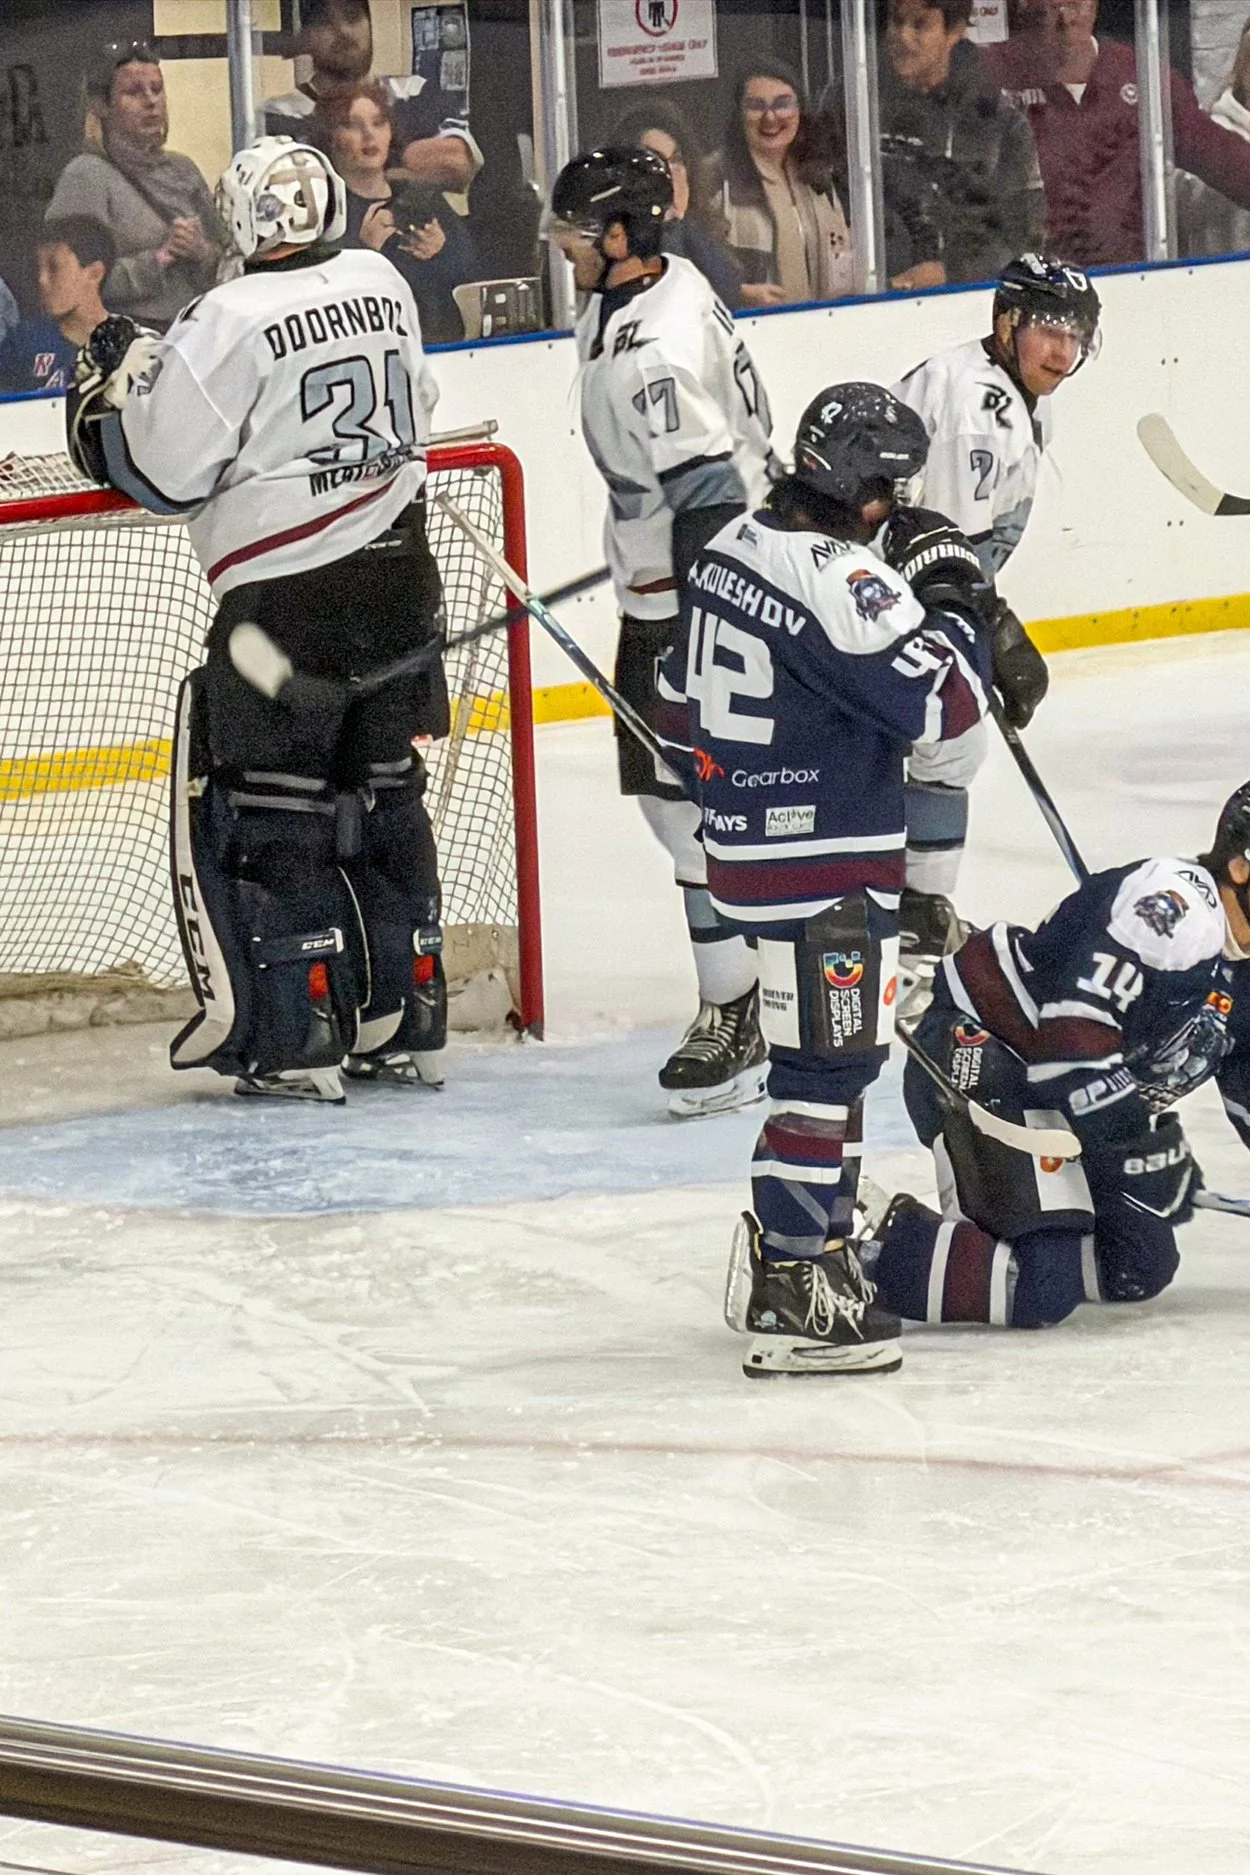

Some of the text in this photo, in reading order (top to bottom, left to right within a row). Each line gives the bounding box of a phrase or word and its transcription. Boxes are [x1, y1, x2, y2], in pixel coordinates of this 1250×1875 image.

[685, 605, 775, 746] 42
[731, 768, 821, 788] Gearbox
[301, 938, 335, 951] CCM
[1076, 952, 1145, 1014] 14
[829, 990, 844, 1048] DISPLAYS
[840, 989, 853, 1037] SCREEN
[850, 988, 863, 1035] DIGITAL
